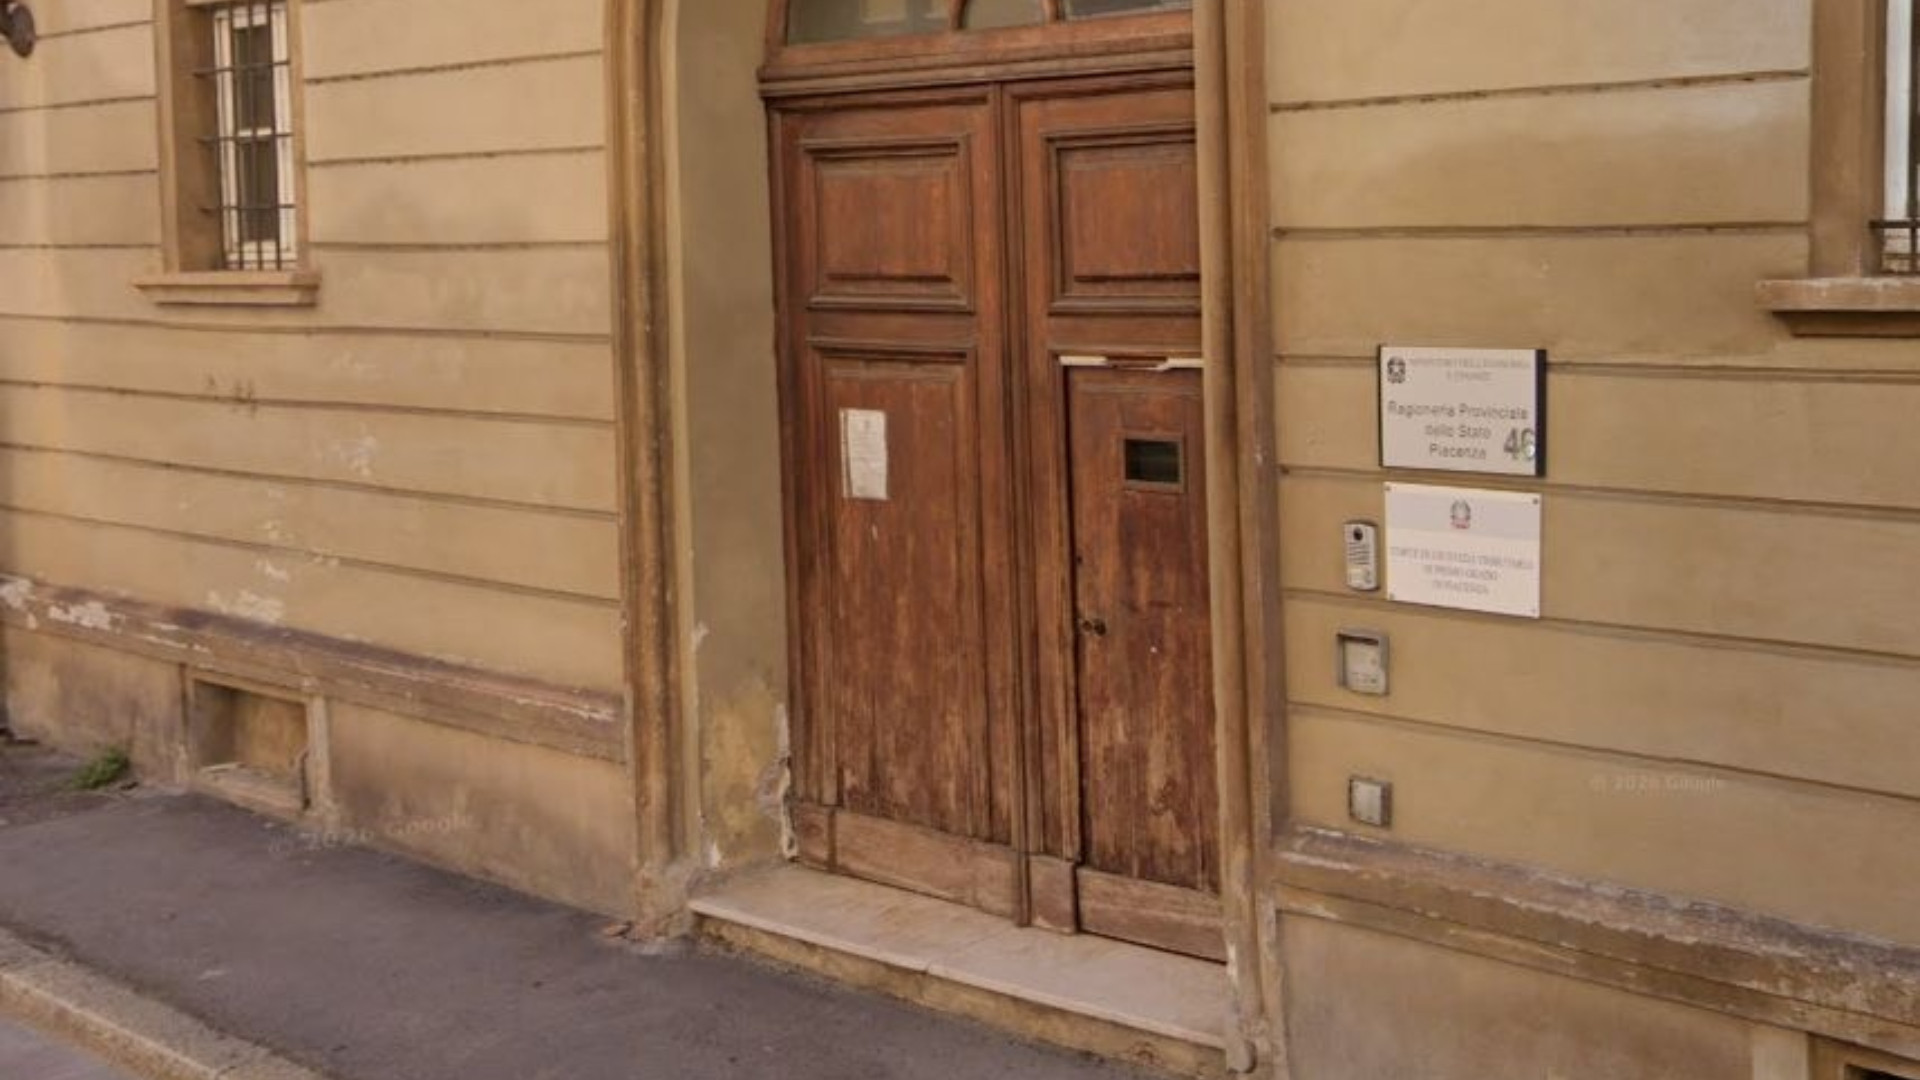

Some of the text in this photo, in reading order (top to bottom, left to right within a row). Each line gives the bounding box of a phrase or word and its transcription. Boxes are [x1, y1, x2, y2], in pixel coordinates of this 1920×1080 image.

[1387, 400, 1528, 419] Ragioneria Provinciale
[1425, 425, 1491, 439] dello Stato
[1430, 443, 1487, 459] Piacenza
[1503, 427, 1534, 461] 46
